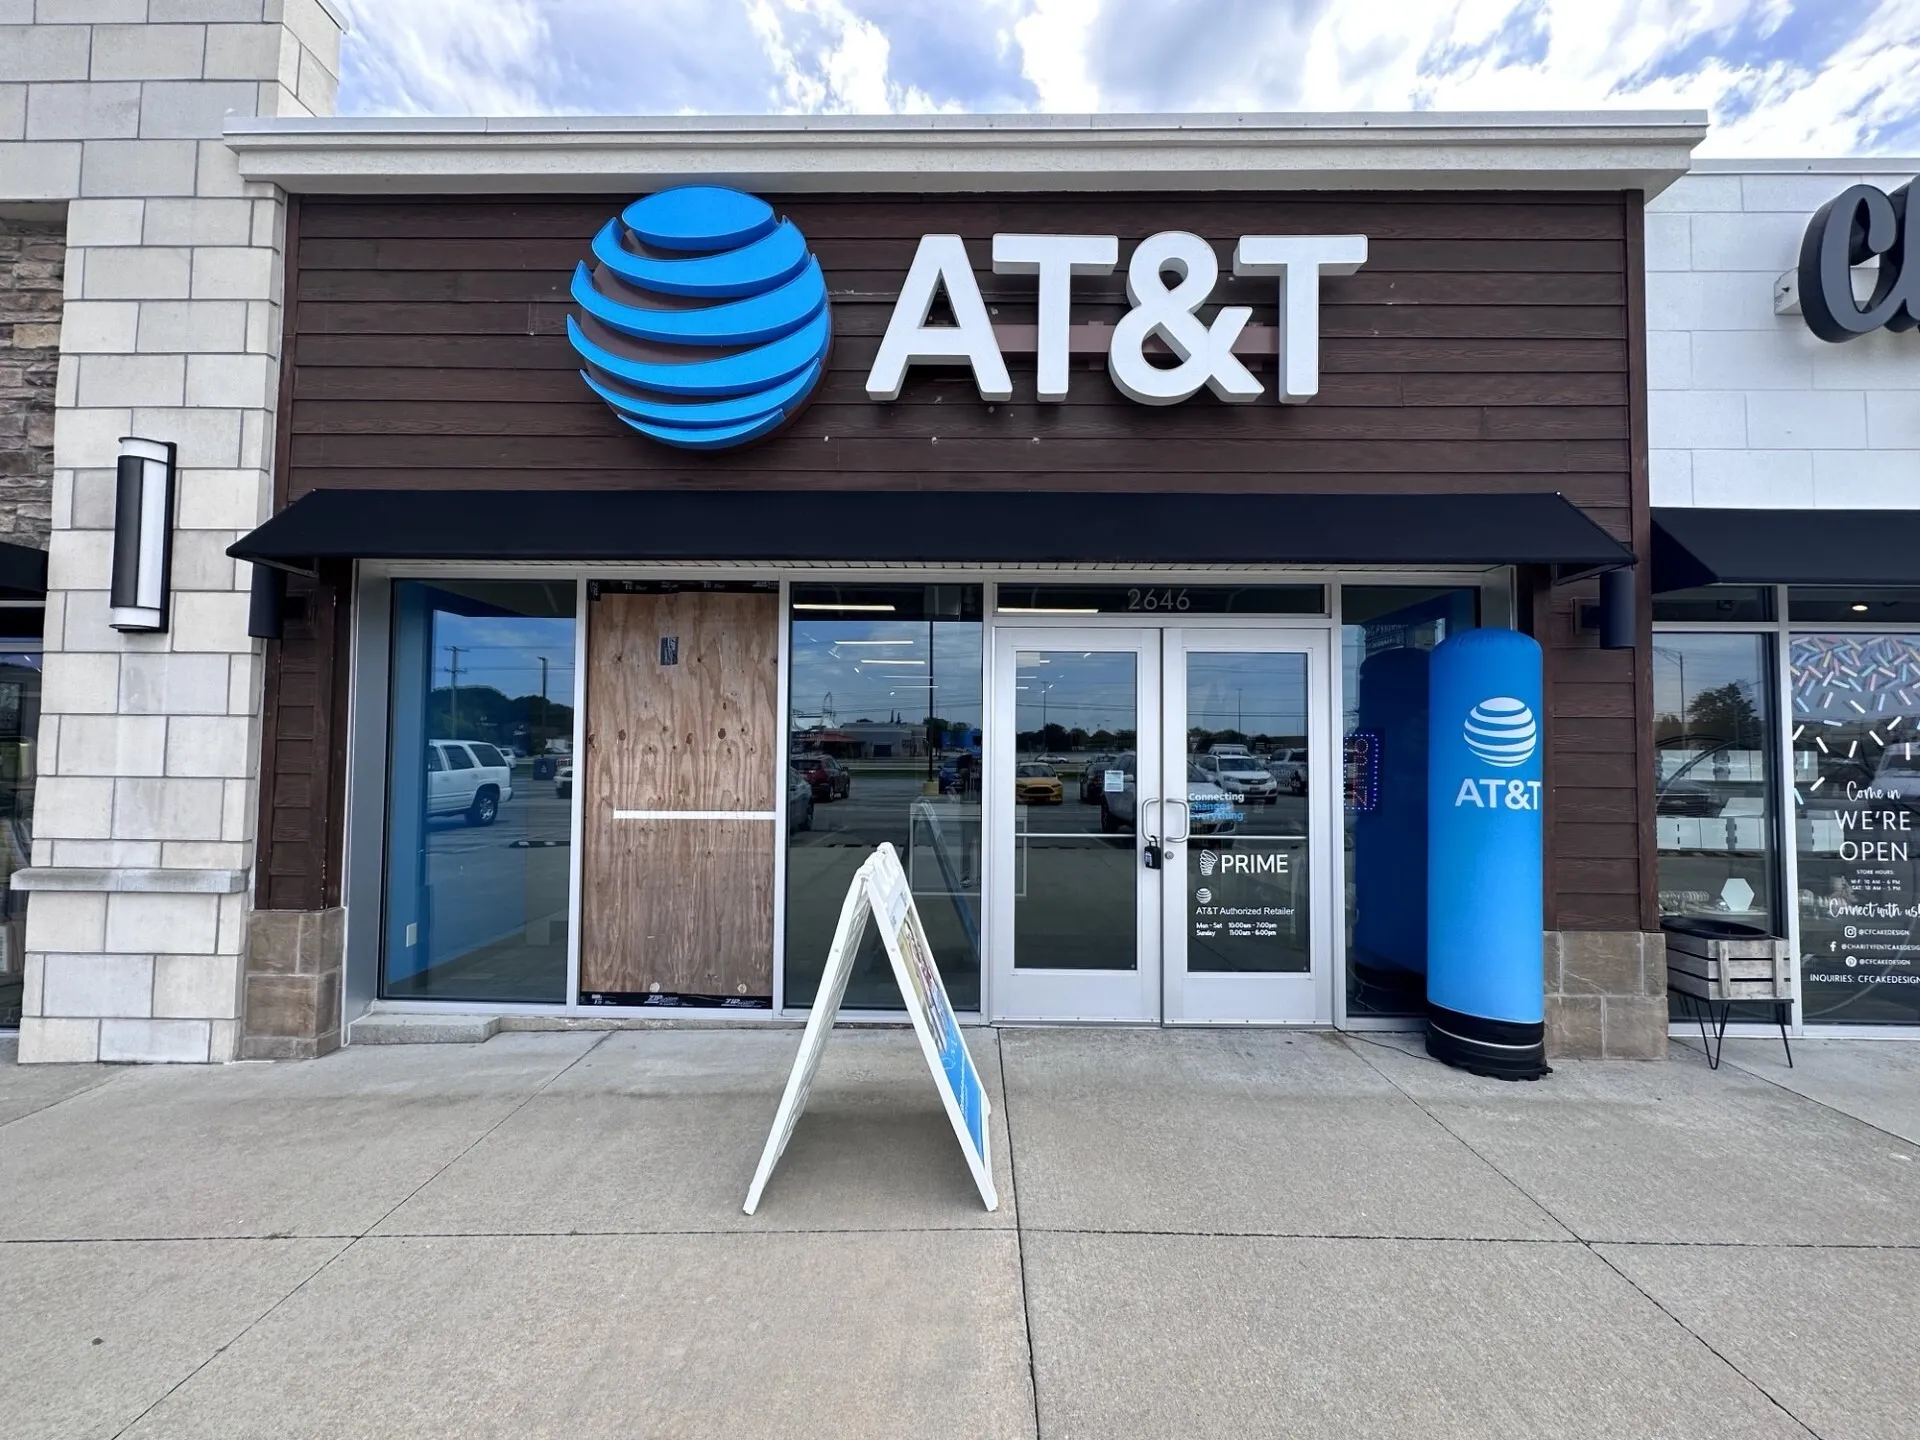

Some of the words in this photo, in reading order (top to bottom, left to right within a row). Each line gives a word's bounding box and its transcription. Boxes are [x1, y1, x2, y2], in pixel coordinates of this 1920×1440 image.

[865, 232, 1368, 405] AT&T
[1128, 588, 1190, 610] 2646
[1189, 791, 1245, 803] Connecting
[1455, 778, 1541, 810] AT&T
[1847, 780, 1884, 802] Come
[1887, 788, 1901, 800] in
[1834, 810, 1912, 831] WE'RE
[1840, 841, 1908, 861] OPEN
[1221, 854, 1289, 874] PRIME
[1196, 906, 1218, 915] AT&T
[1220, 906, 1262, 915] Authorized
[1264, 906, 1295, 915] Retailer
[1829, 898, 1878, 918] Connect
[1876, 902, 1902, 918] with
[1196, 930, 1216, 938] Sunday
[1810, 974, 1854, 983] INQUIRIES:
